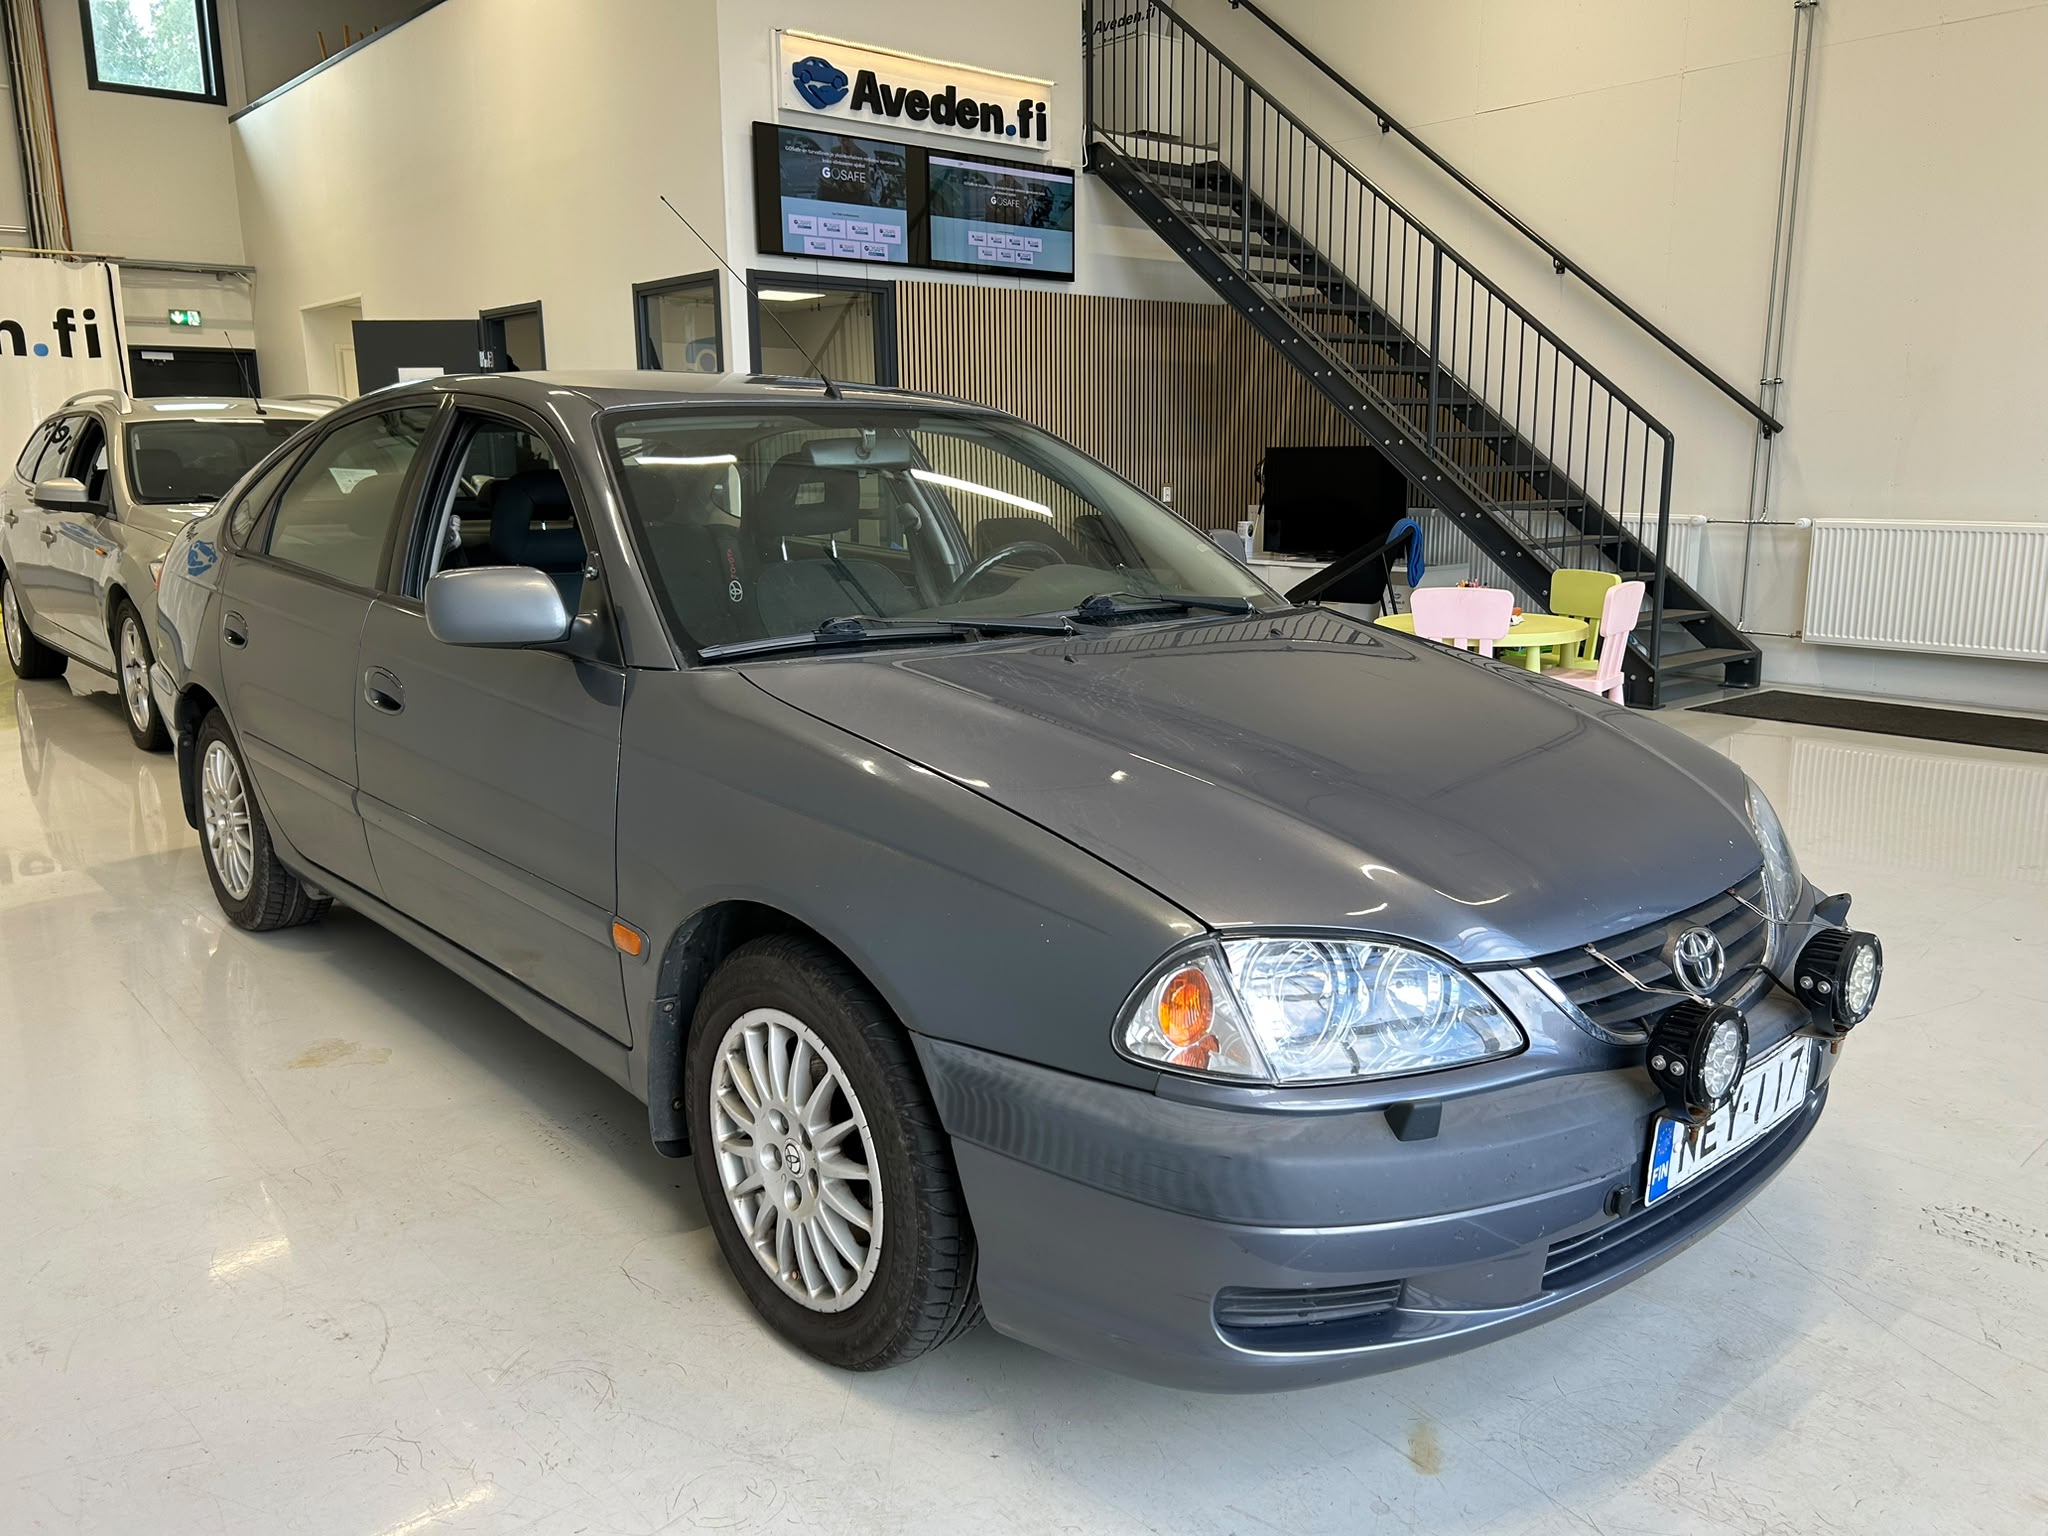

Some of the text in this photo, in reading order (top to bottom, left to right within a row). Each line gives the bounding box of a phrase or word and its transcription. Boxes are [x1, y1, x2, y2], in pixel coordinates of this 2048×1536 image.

[850, 69, 1047, 142] Aveden.fi
[822, 167, 866, 183] GOSAFE
[990, 196, 1020, 208] GOSAFE
[0, 307, 102, 359] n.fi
[1651, 1161, 1669, 1186] FIN
